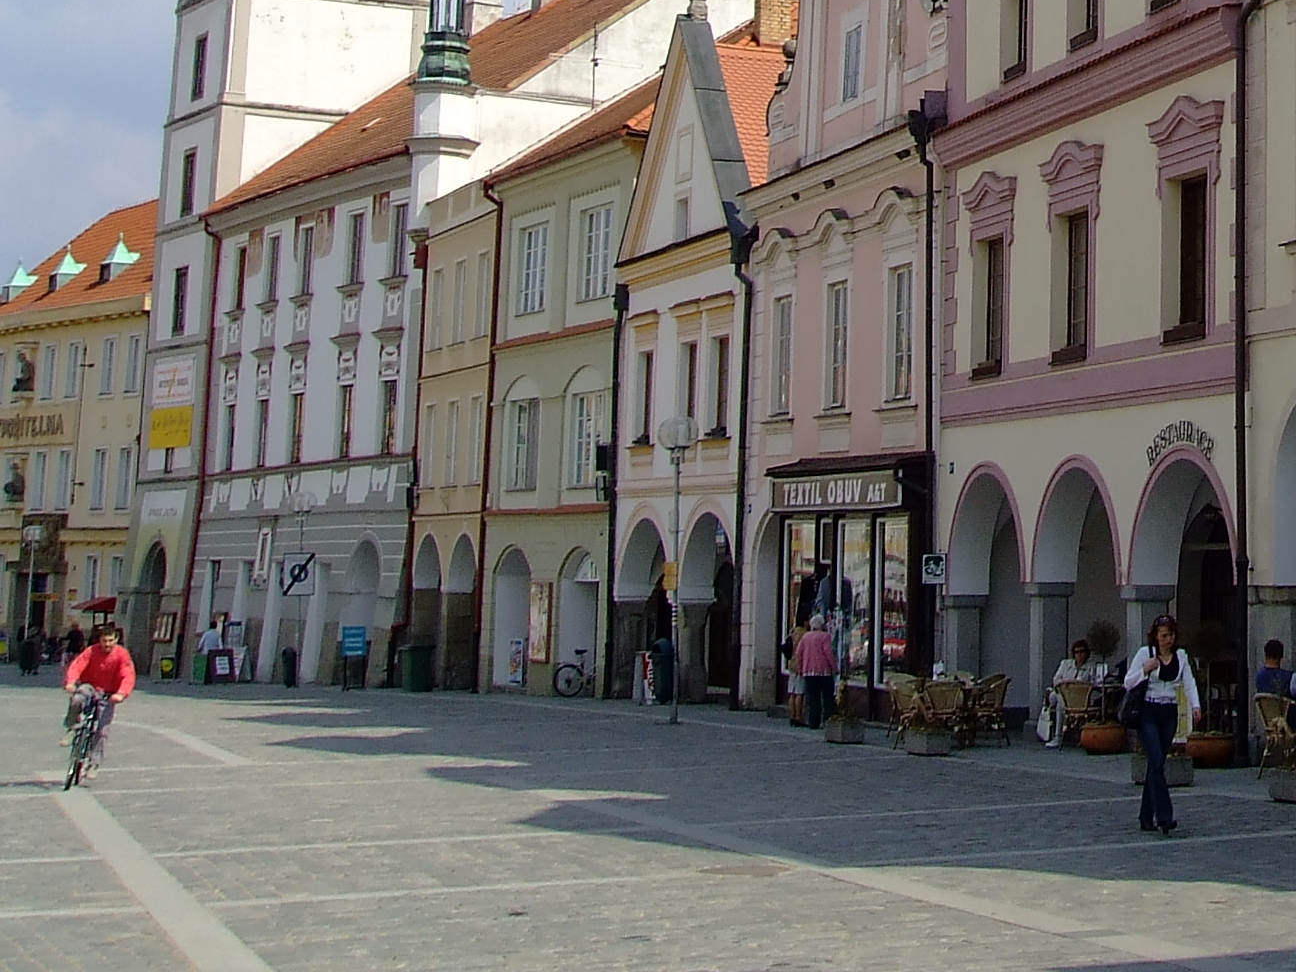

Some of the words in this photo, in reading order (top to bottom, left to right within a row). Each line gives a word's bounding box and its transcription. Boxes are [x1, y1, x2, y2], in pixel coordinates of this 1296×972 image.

[1146, 420, 1214, 467] RESTAURACE
[783, 481, 821, 505] TEXTIL
[827, 479, 862, 503] OBUV
